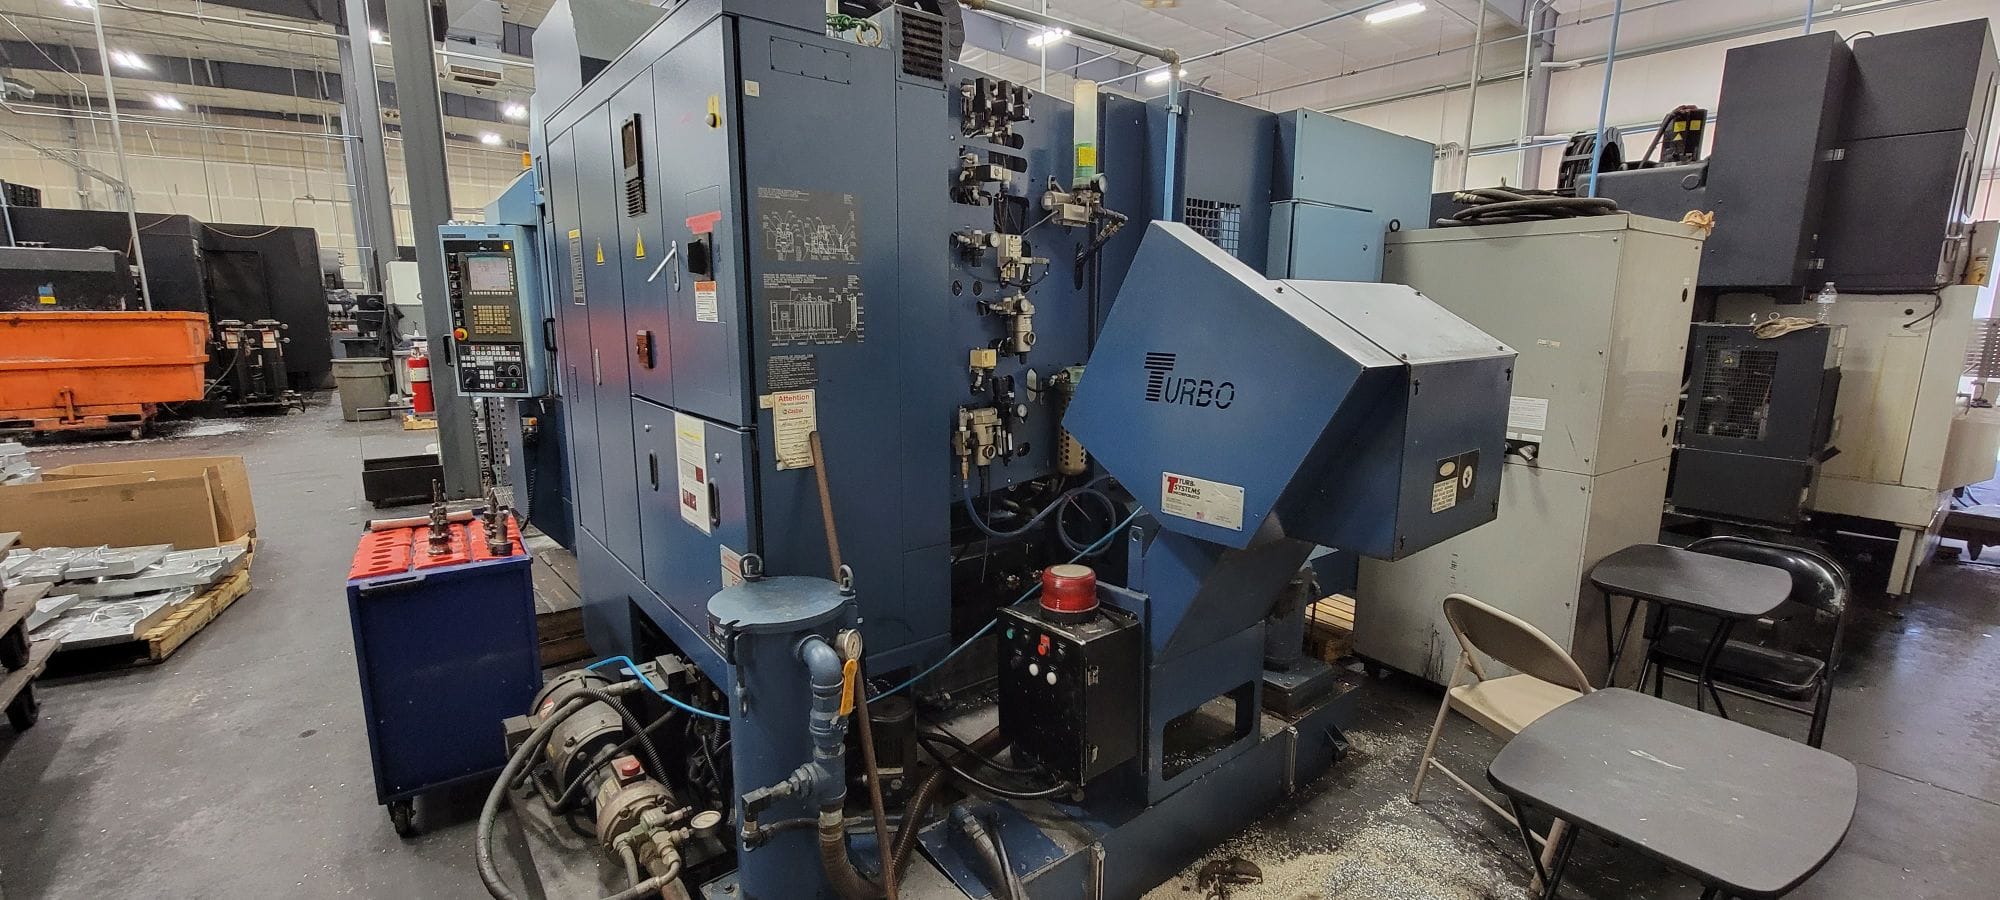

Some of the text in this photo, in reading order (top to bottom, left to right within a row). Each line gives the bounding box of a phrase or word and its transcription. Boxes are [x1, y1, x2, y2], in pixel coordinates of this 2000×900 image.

[1144, 352, 1235, 410] TURBO
[778, 393, 810, 402] Attention
[1173, 484, 1201, 496] SYSTEMS
